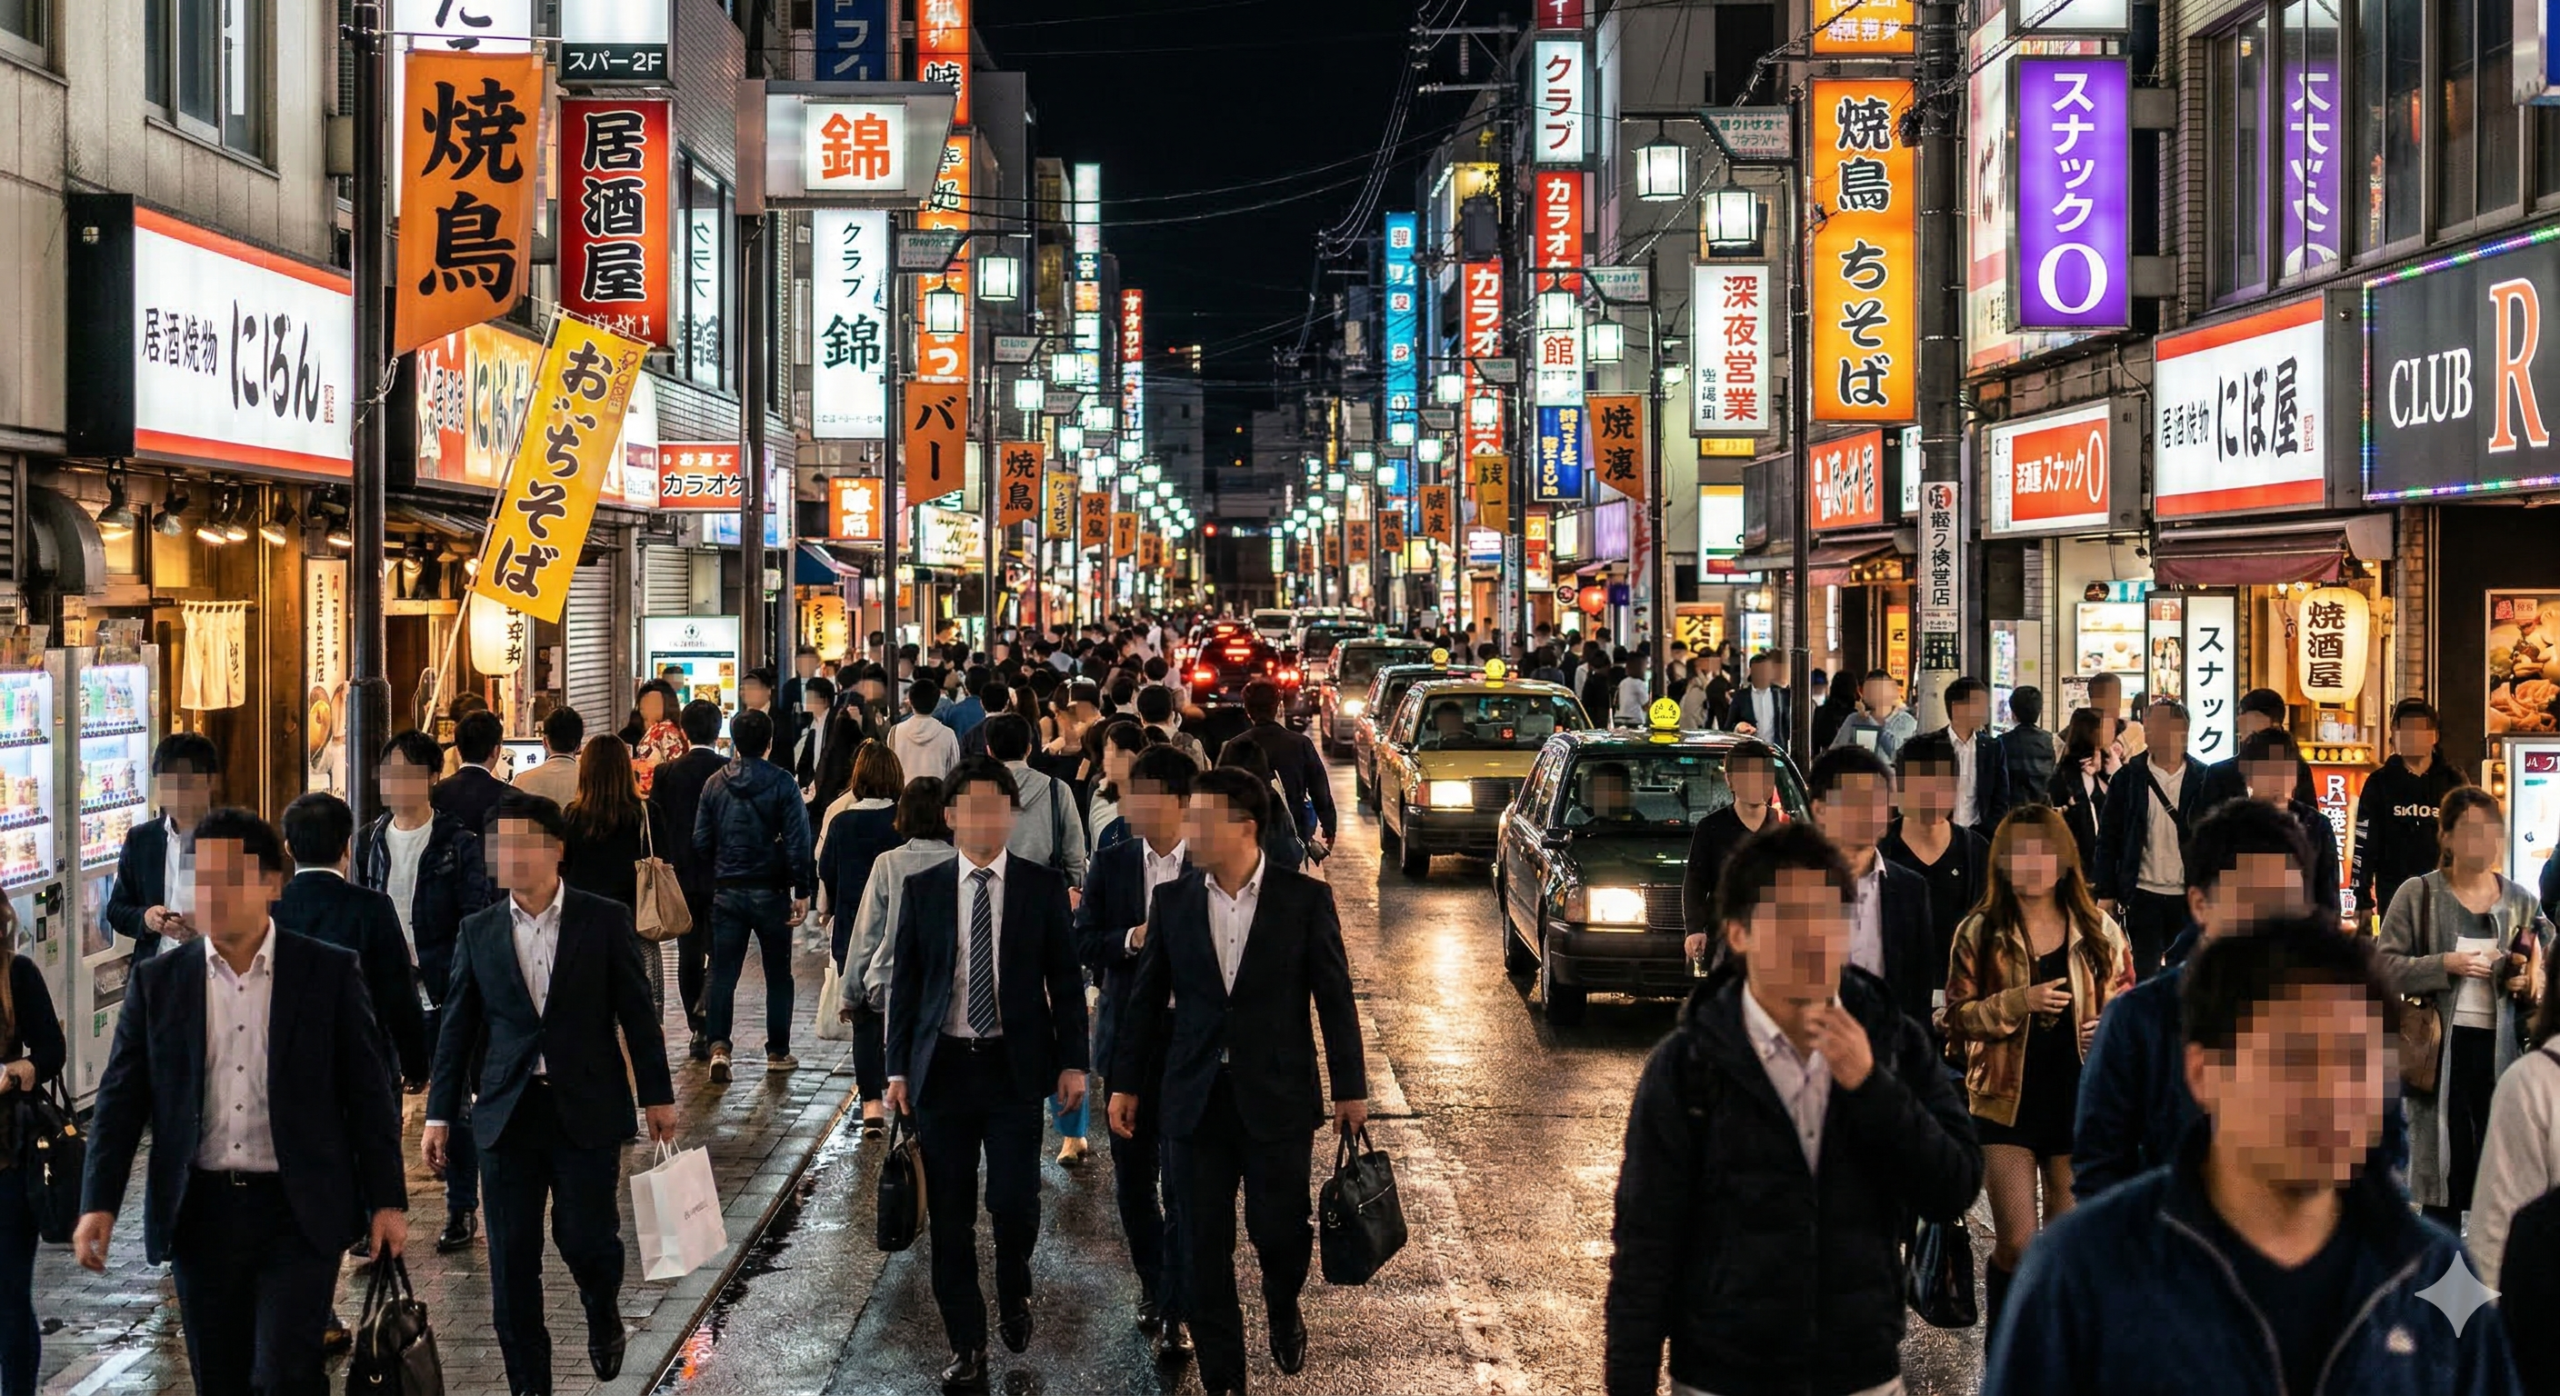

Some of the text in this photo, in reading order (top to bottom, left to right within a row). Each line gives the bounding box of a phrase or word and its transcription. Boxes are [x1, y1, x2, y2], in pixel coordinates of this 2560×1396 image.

[568, 50, 662, 71] スパー 2F
[1546, 54, 1574, 150] クラブ
[418, 77, 526, 303] 焼鳥
[821, 113, 890, 180] 錦
[2052, 73, 2094, 233] スナック
[581, 110, 647, 304] 居酒屋
[842, 222, 866, 297] クラブ
[822, 314, 880, 372] 錦
[1543, 335, 1574, 365] 館
[1723, 275, 1758, 422] 深夜営業
[2388, 278, 2550, 454] CLUB R
[914, 395, 957, 481] バー
[2043, 448, 2085, 493] スナック
[662, 471, 742, 497] カラオケ
[2307, 600, 2346, 689] 焼酒屋
[2197, 626, 2225, 755] スナック
